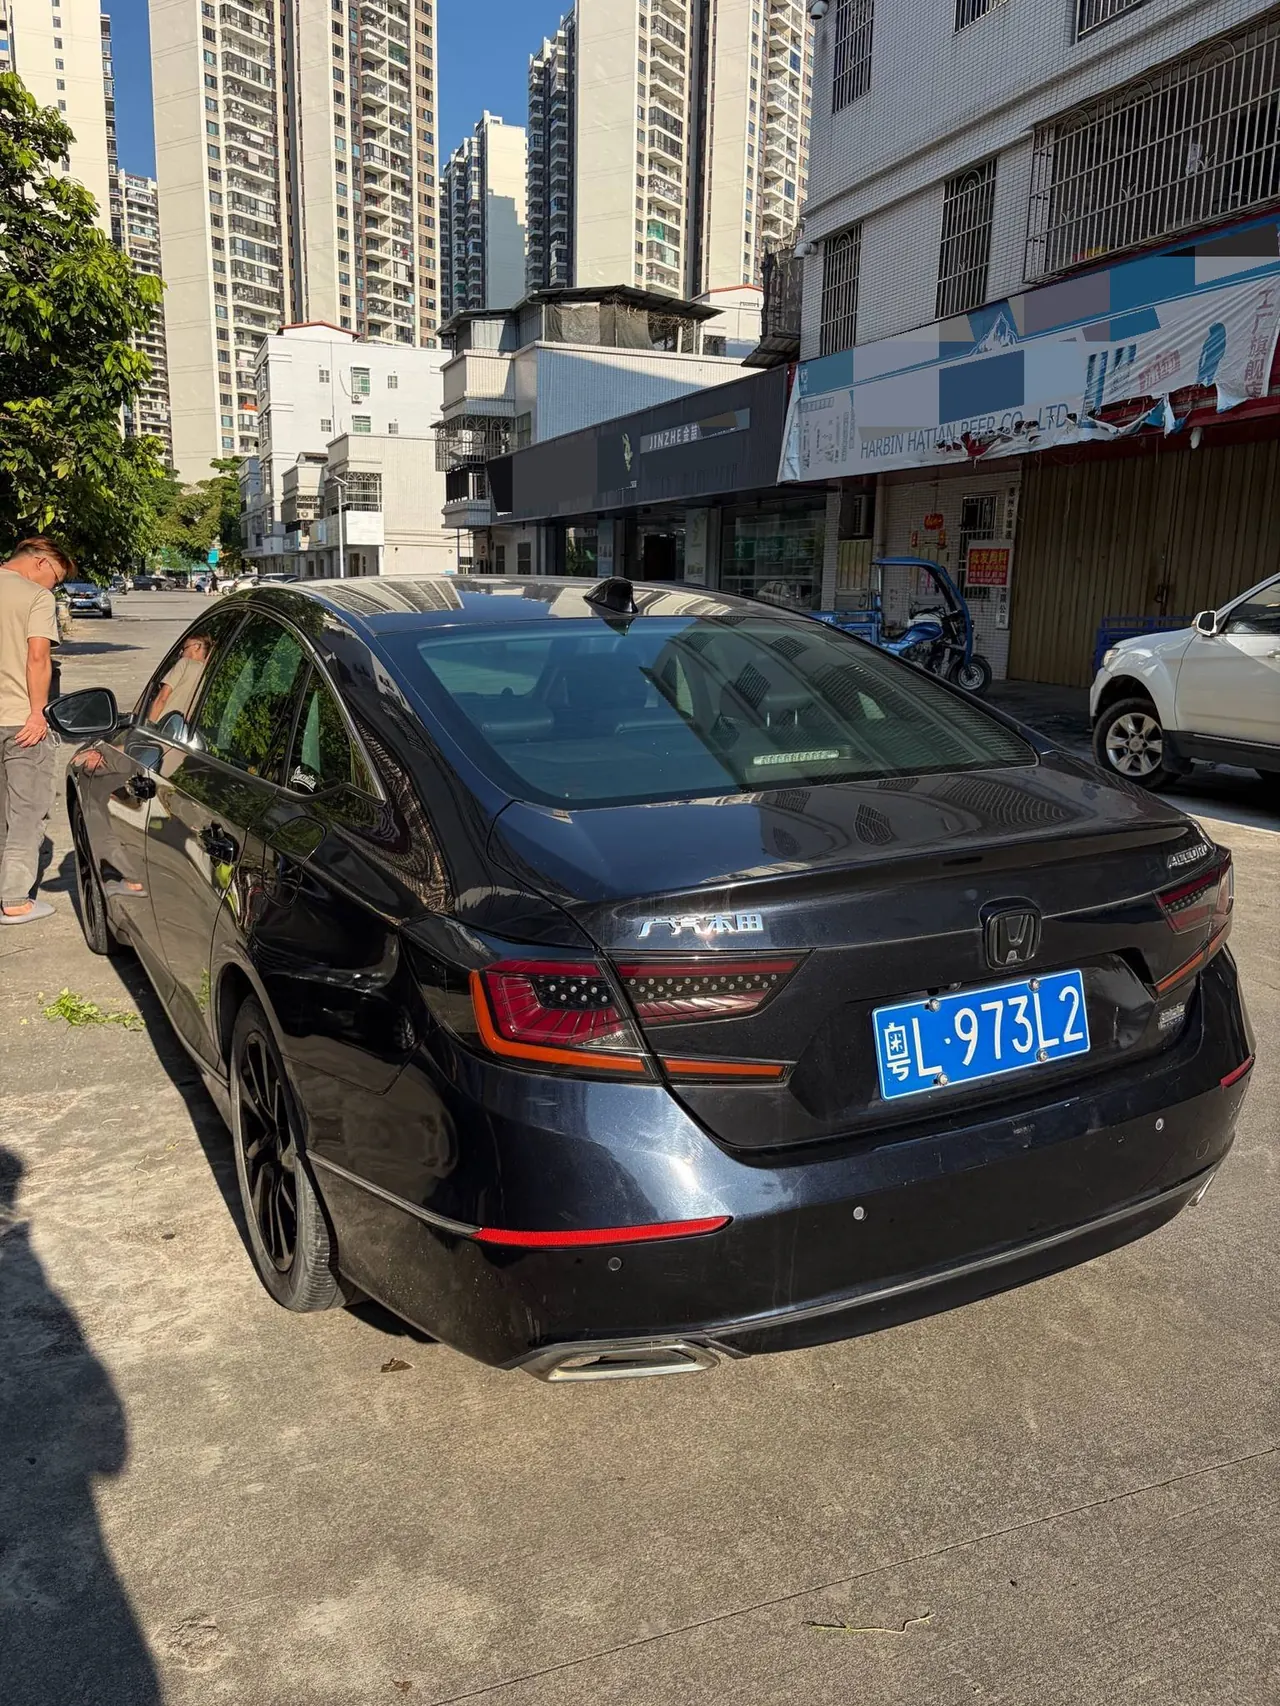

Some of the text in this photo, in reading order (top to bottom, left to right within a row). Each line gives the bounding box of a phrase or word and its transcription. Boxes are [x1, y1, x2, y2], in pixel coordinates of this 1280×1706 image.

[649, 428, 682, 450] JINZHE
[861, 433, 904, 459] HARBIN
[636, 913, 765, 939] 广汽本田
